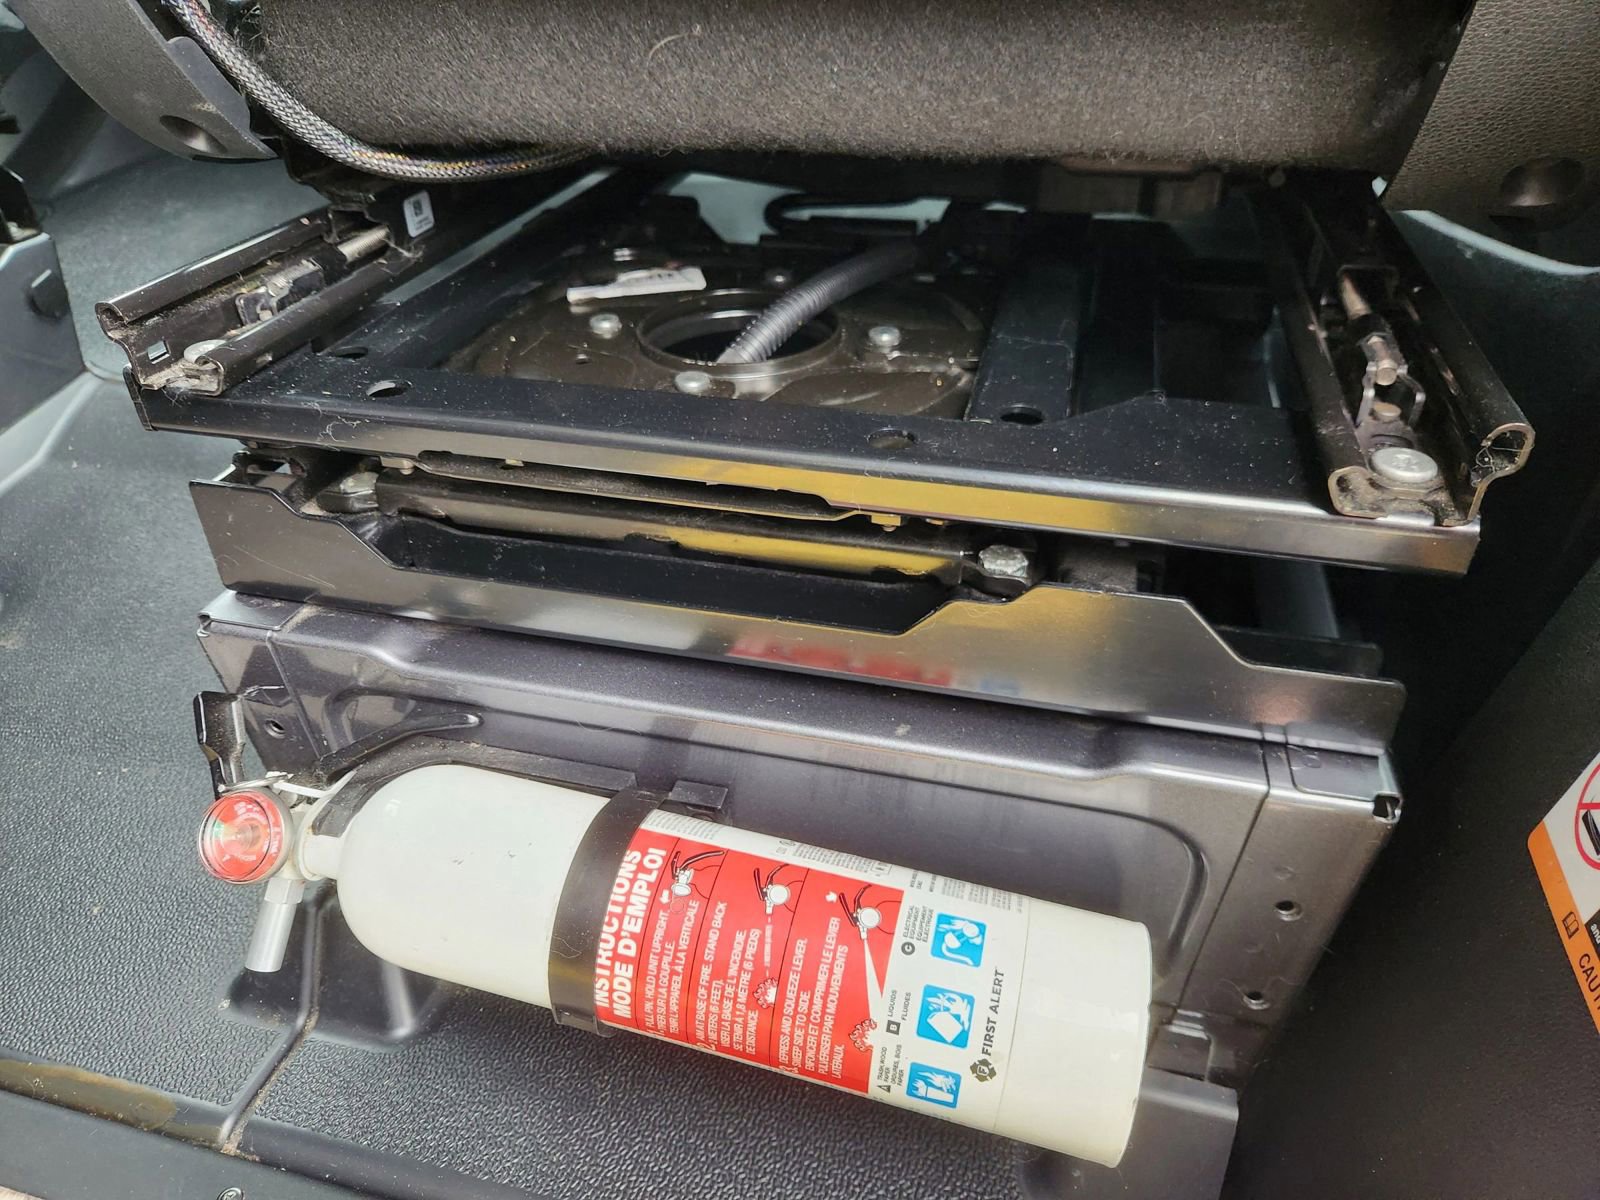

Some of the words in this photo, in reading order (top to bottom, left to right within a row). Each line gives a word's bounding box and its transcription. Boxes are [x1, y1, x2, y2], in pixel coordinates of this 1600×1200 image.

[677, 899, 699, 950] VERTICALE
[711, 900, 727, 928] BACK
[902, 905, 914, 937] ELECTRICAL
[594, 848, 641, 1007] INSTRUCTIONS
[651, 909, 670, 952] UPRIGHT.
[823, 915, 841, 948] LEVIER
[703, 927, 720, 962] STAND
[745, 928, 762, 960] PIEDS)
[647, 952, 660, 975] UNIT
[675, 950, 686, 963] LA
[743, 959, 755, 970] (6
[820, 948, 833, 963] LE
[613, 961, 634, 1018] MODE
[644, 974, 656, 998] HOLD
[825, 944, 848, 1013] MOUVEMENTS
[1579, 953, 1600, 1010] CAU
[657, 985, 667, 998] LA
[696, 984, 707, 999] OF
[724, 983, 735, 998] DE
[782, 970, 800, 1015] SQUEEZE
[797, 990, 810, 1013] SIDE.
[809, 963, 830, 1023] COMPRIMER
[657, 997, 666, 1013] SUR
[695, 998, 706, 1020] BASE
[708, 1003, 720, 1013] (6
[721, 997, 733, 1020] BASE
[735, 1002, 747, 1016] 1,8
[887, 989, 896, 1016] LIQUIDS
[901, 991, 911, 1020] FLUIDES
[645, 1013, 654, 1027] PULL
[695, 1018, 705, 1030] AT
[708, 1012, 718, 1040] METERS
[720, 1020, 730, 1031] LA
[780, 1015, 792, 1035] AND
[795, 1013, 806, 1026] TO
[807, 1022, 819, 1035] ET
[822, 1014, 834, 1033] PAR
[733, 1022, 744, 1042] TENIR
[793, 1026, 805, 1045] SIDE
[981, 1016, 996, 1055] FIRST
[733, 1041, 742, 1051] SE
[745, 1044, 755, 1054] DE
[778, 1034, 790, 1063] DEPRESS
[791, 1045, 803, 1067] SWEEP
[804, 1035, 817, 1070] ENFONCER
[879, 1046, 887, 1064] WOOD
[894, 1043, 902, 1058] BOIS
